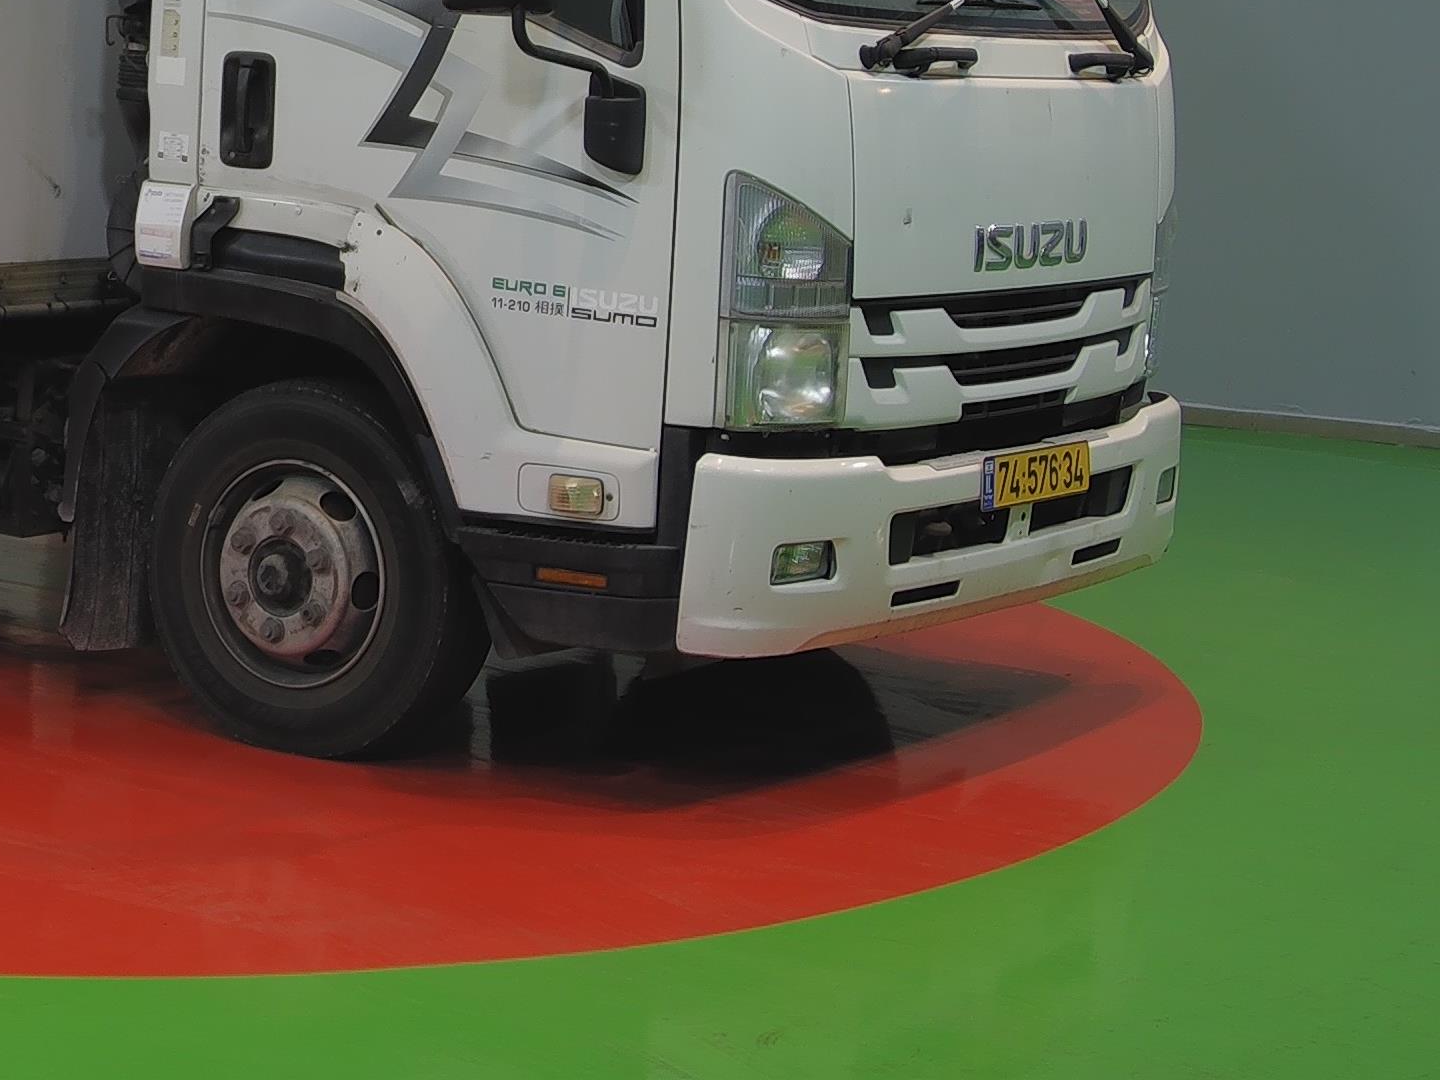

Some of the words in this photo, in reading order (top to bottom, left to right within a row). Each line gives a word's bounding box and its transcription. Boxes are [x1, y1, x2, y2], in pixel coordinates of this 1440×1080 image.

[973, 218, 1088, 273] ISUZU
[492, 277, 547, 297] EURO
[552, 284, 567, 298] 6
[491, 297, 531, 313] 11-210
[571, 286, 658, 314] ISUZU
[571, 307, 658, 328] SUMO
